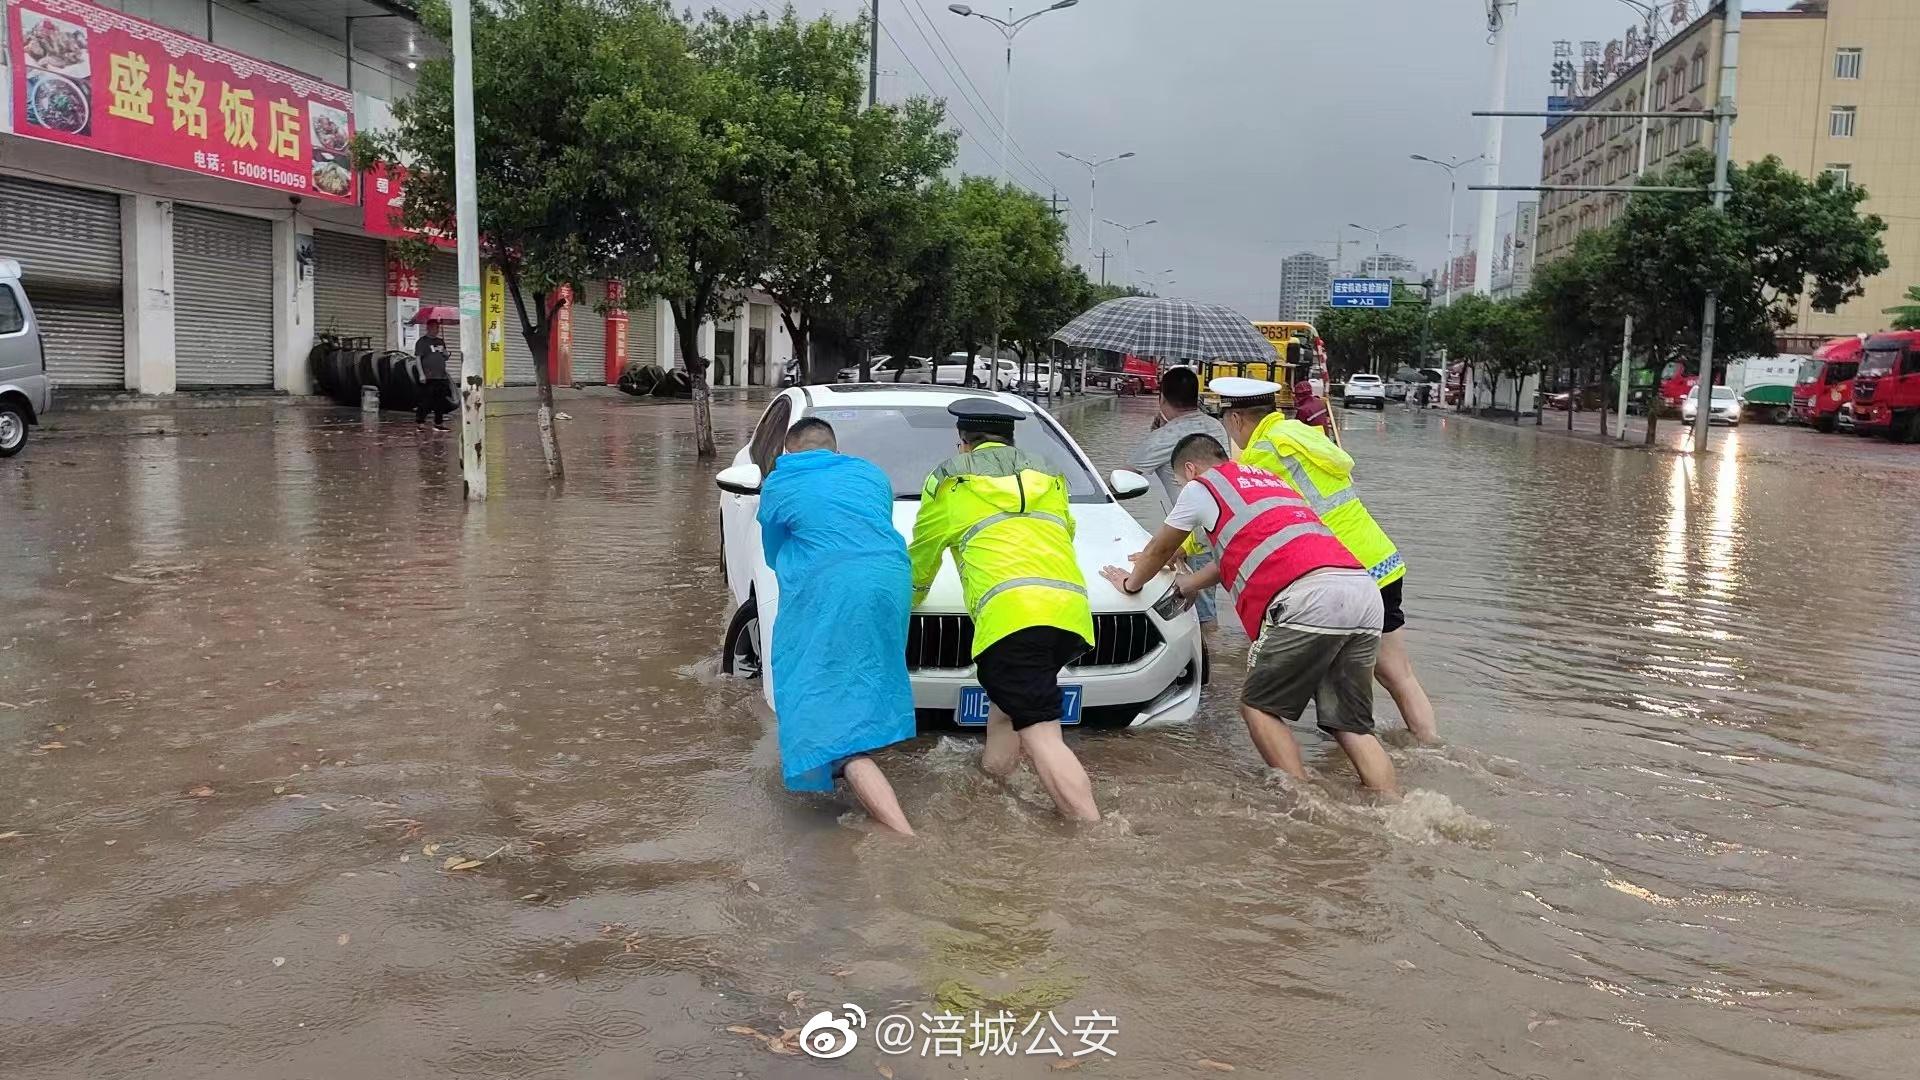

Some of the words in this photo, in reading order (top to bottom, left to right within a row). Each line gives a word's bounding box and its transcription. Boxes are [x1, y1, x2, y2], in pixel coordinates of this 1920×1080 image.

[108, 50, 300, 161] 盛铭饭店
[232, 160, 306, 188] 15008150059
[1255, 325, 1289, 339] P631
[1064, 691, 1078, 717] 7
